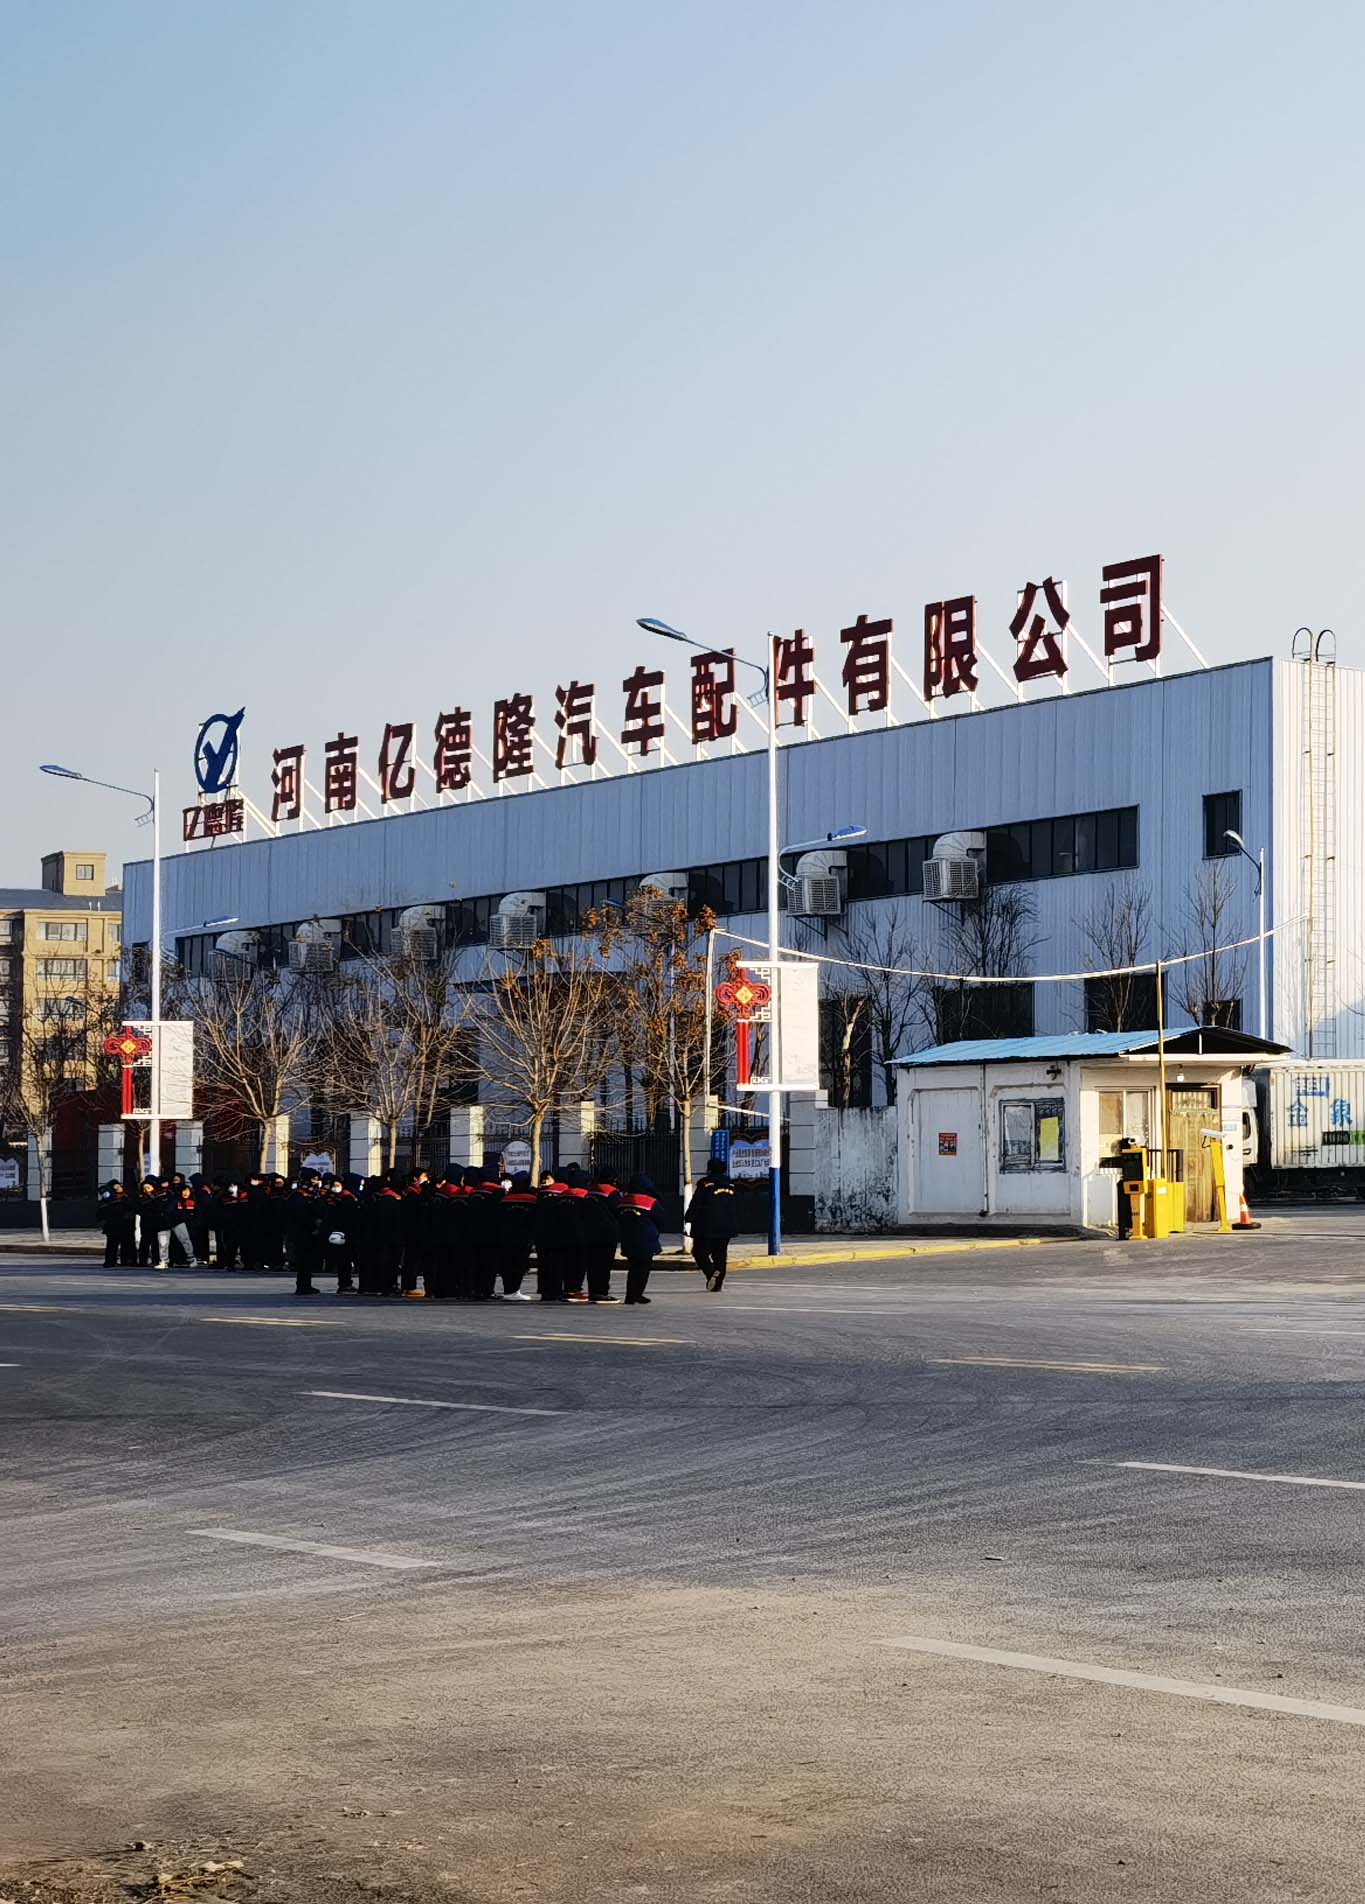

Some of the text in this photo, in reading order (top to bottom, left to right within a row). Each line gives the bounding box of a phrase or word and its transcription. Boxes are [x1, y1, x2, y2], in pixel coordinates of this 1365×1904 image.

[271, 554, 1164, 822] 河南亿德隆汽车配件有限公司
